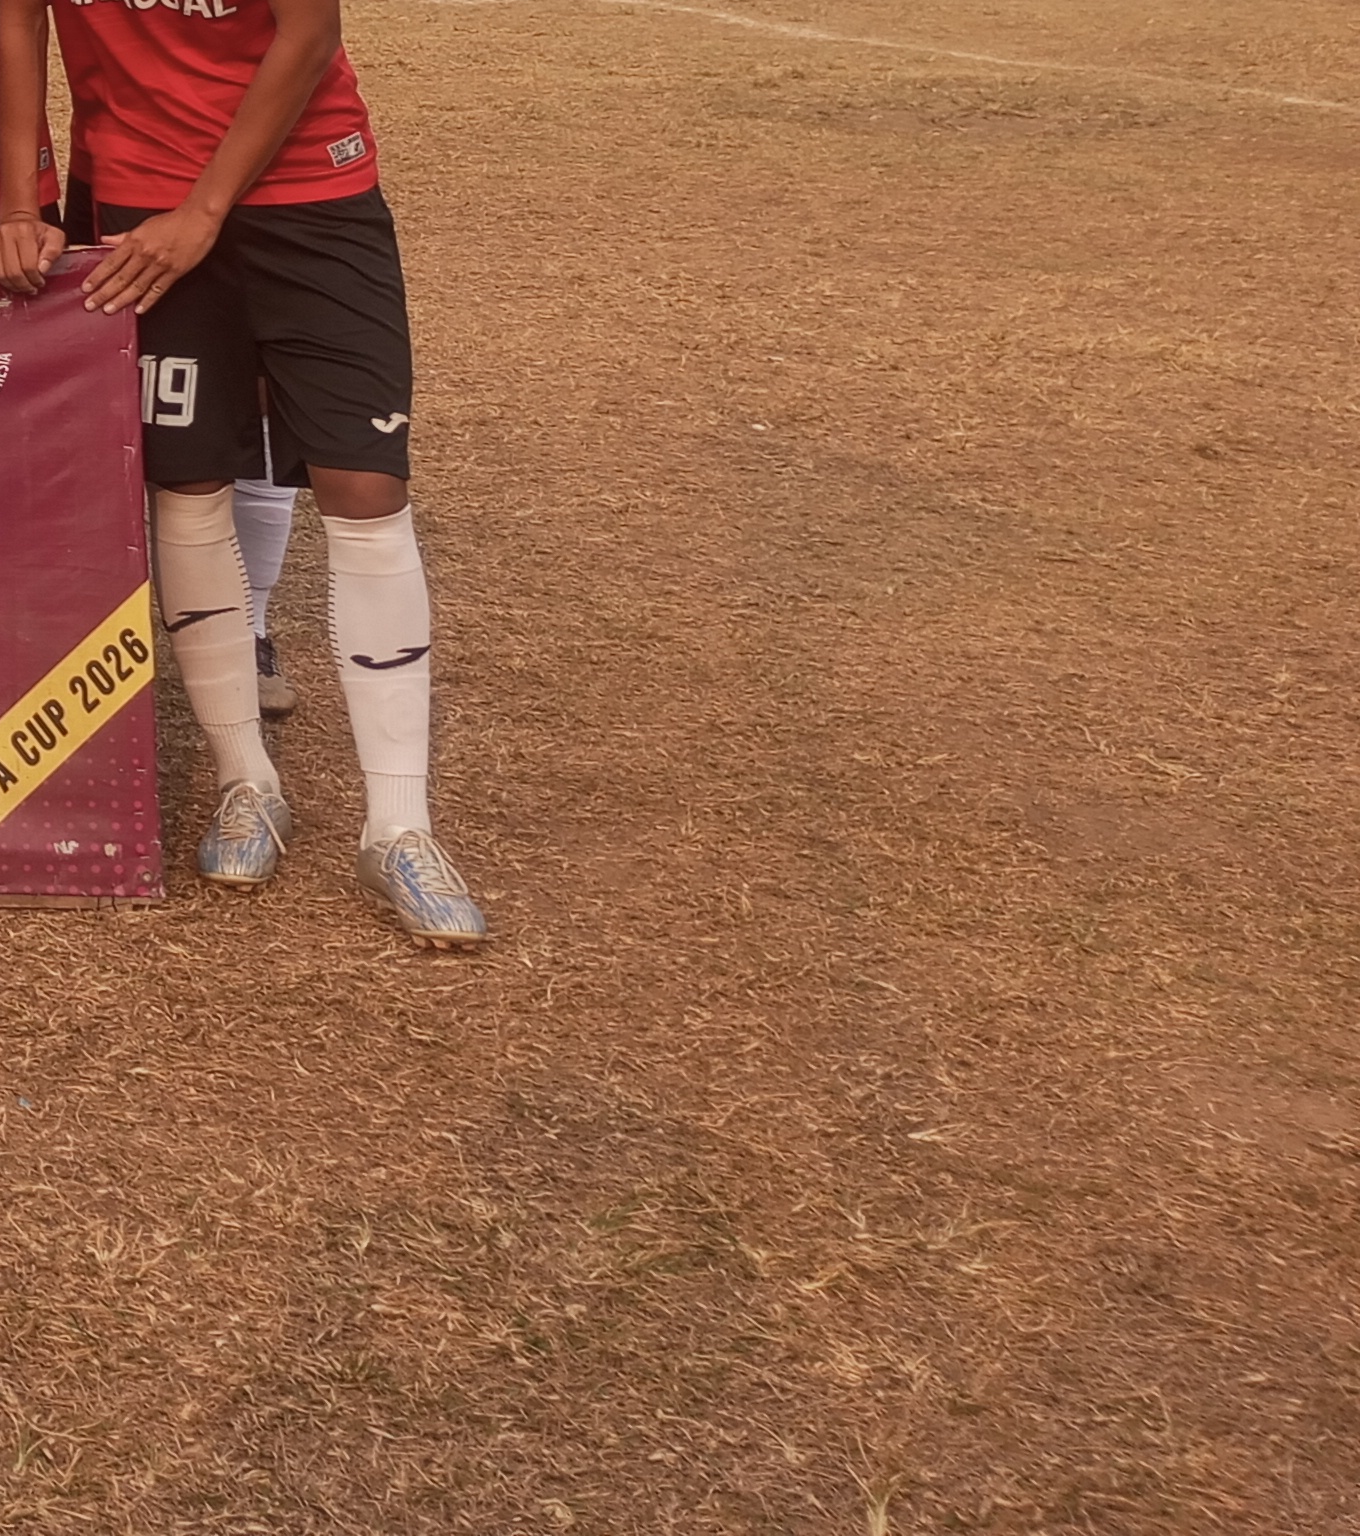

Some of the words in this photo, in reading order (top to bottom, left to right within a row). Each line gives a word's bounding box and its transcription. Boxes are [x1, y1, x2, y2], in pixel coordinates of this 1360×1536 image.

[138, 355, 199, 427] 19
[10, 698, 69, 767] CUP
[68, 627, 149, 714] 2026
